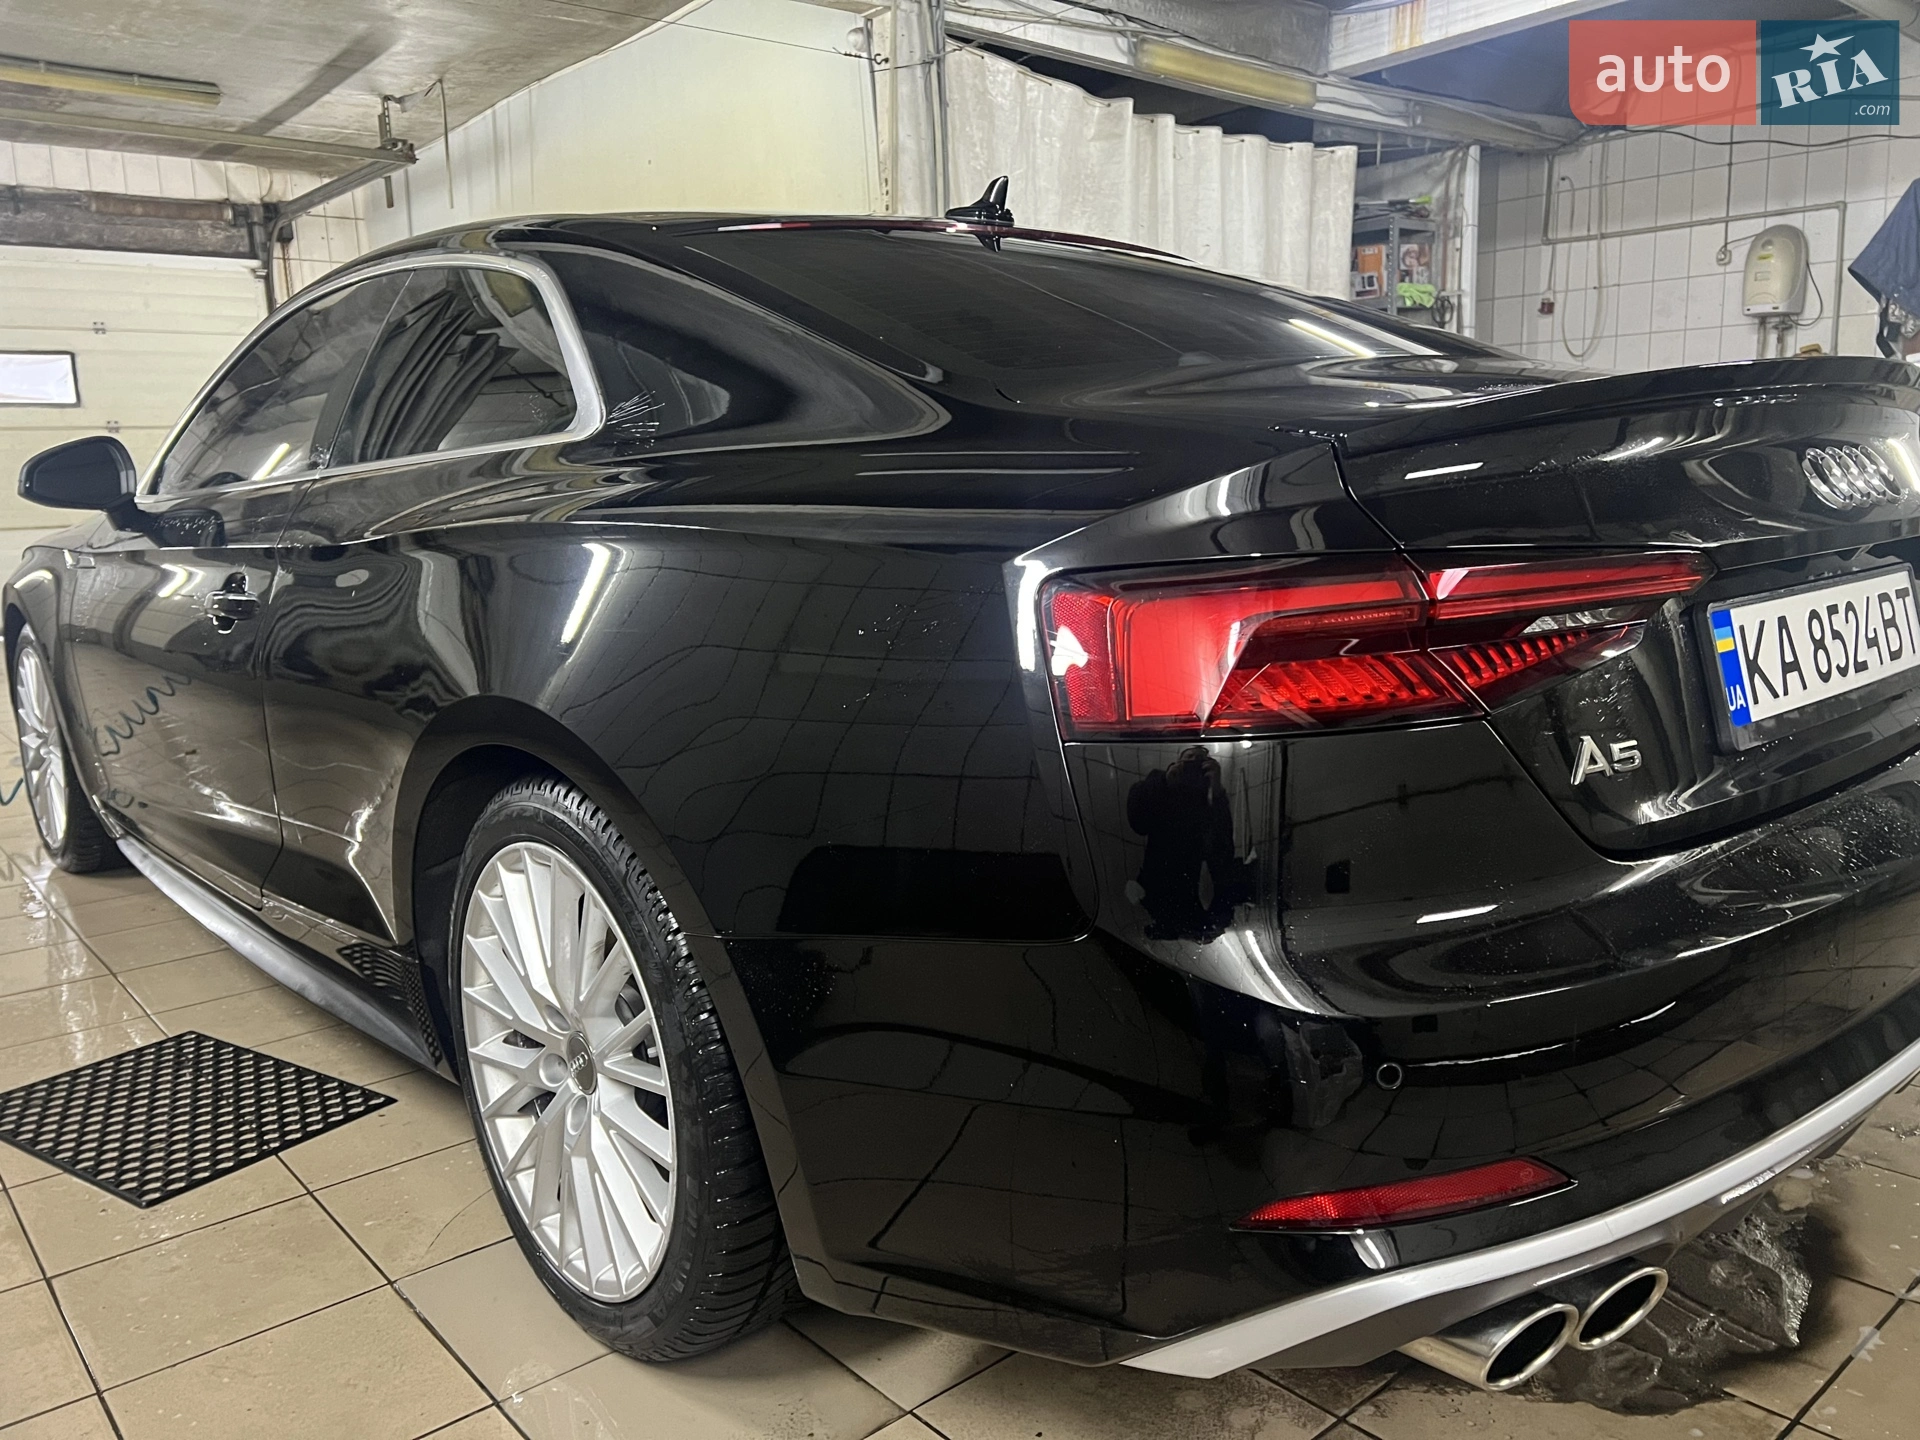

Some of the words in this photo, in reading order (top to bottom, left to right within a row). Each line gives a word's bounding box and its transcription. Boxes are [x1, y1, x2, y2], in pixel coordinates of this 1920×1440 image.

[1738, 614, 1809, 705] KA
[1725, 684, 1747, 711] UA
[1570, 735, 1642, 786] A5
